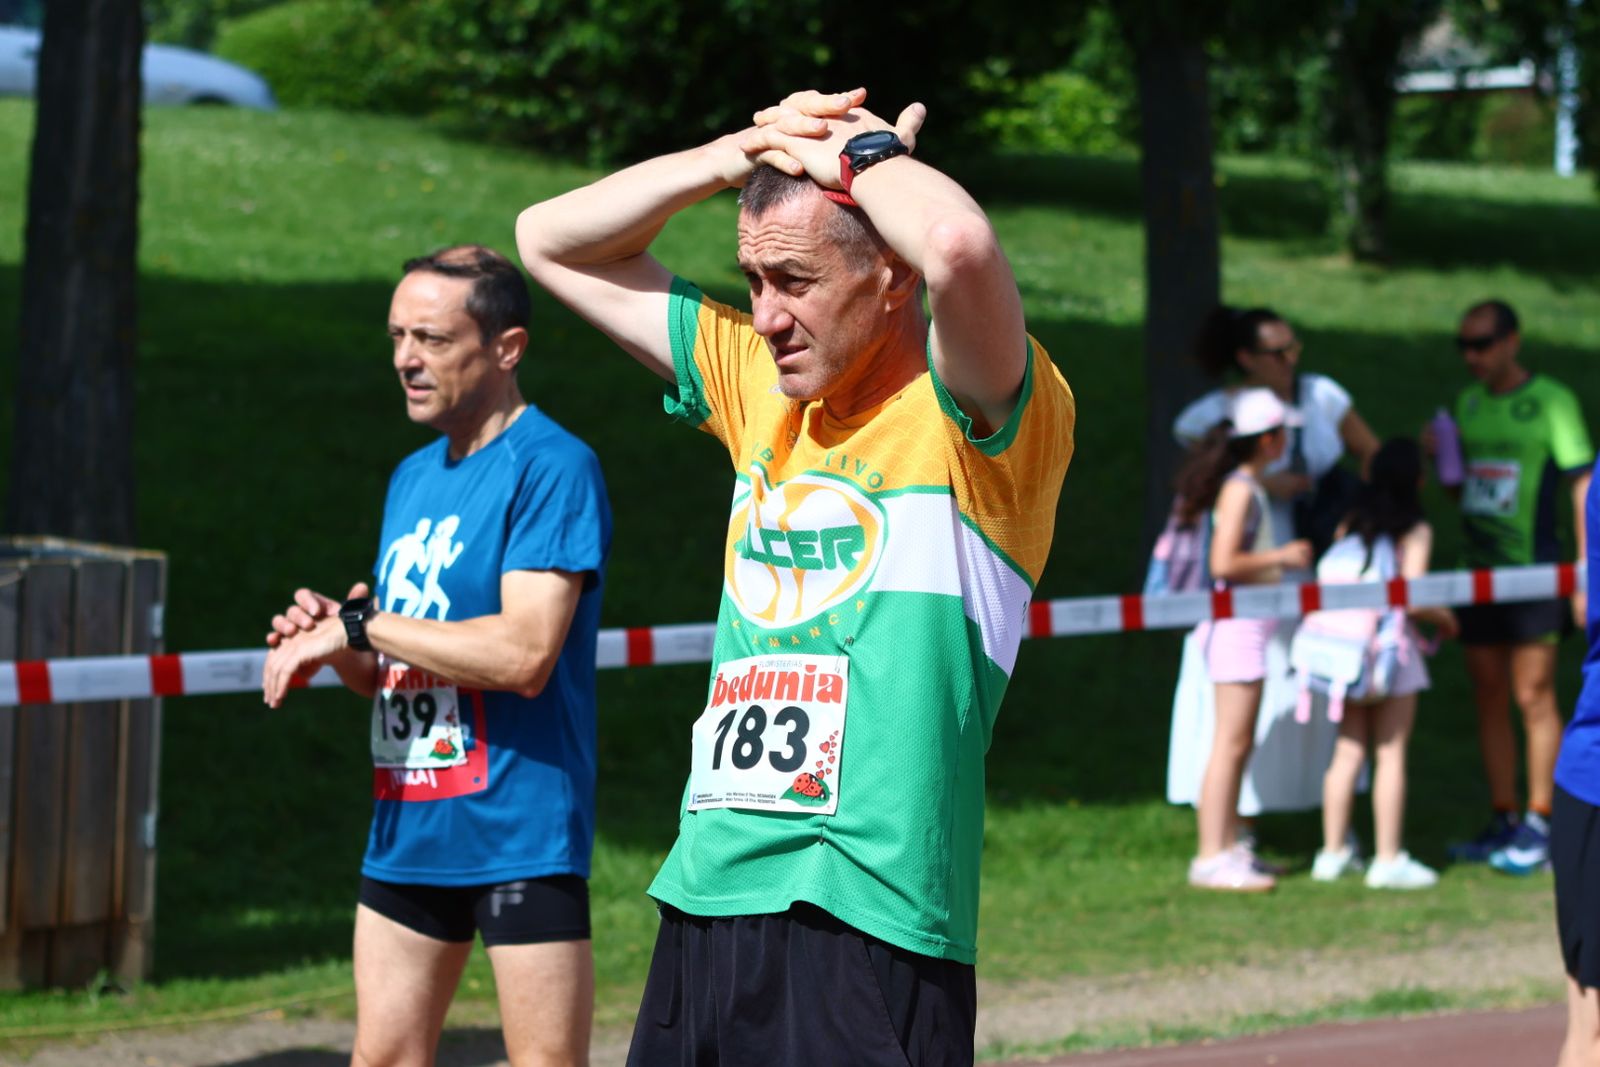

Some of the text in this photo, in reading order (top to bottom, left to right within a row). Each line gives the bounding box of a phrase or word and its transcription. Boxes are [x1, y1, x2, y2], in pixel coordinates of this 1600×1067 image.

[711, 664, 844, 709] bedunia
[380, 692, 437, 741] 139
[712, 704, 810, 773] 183
